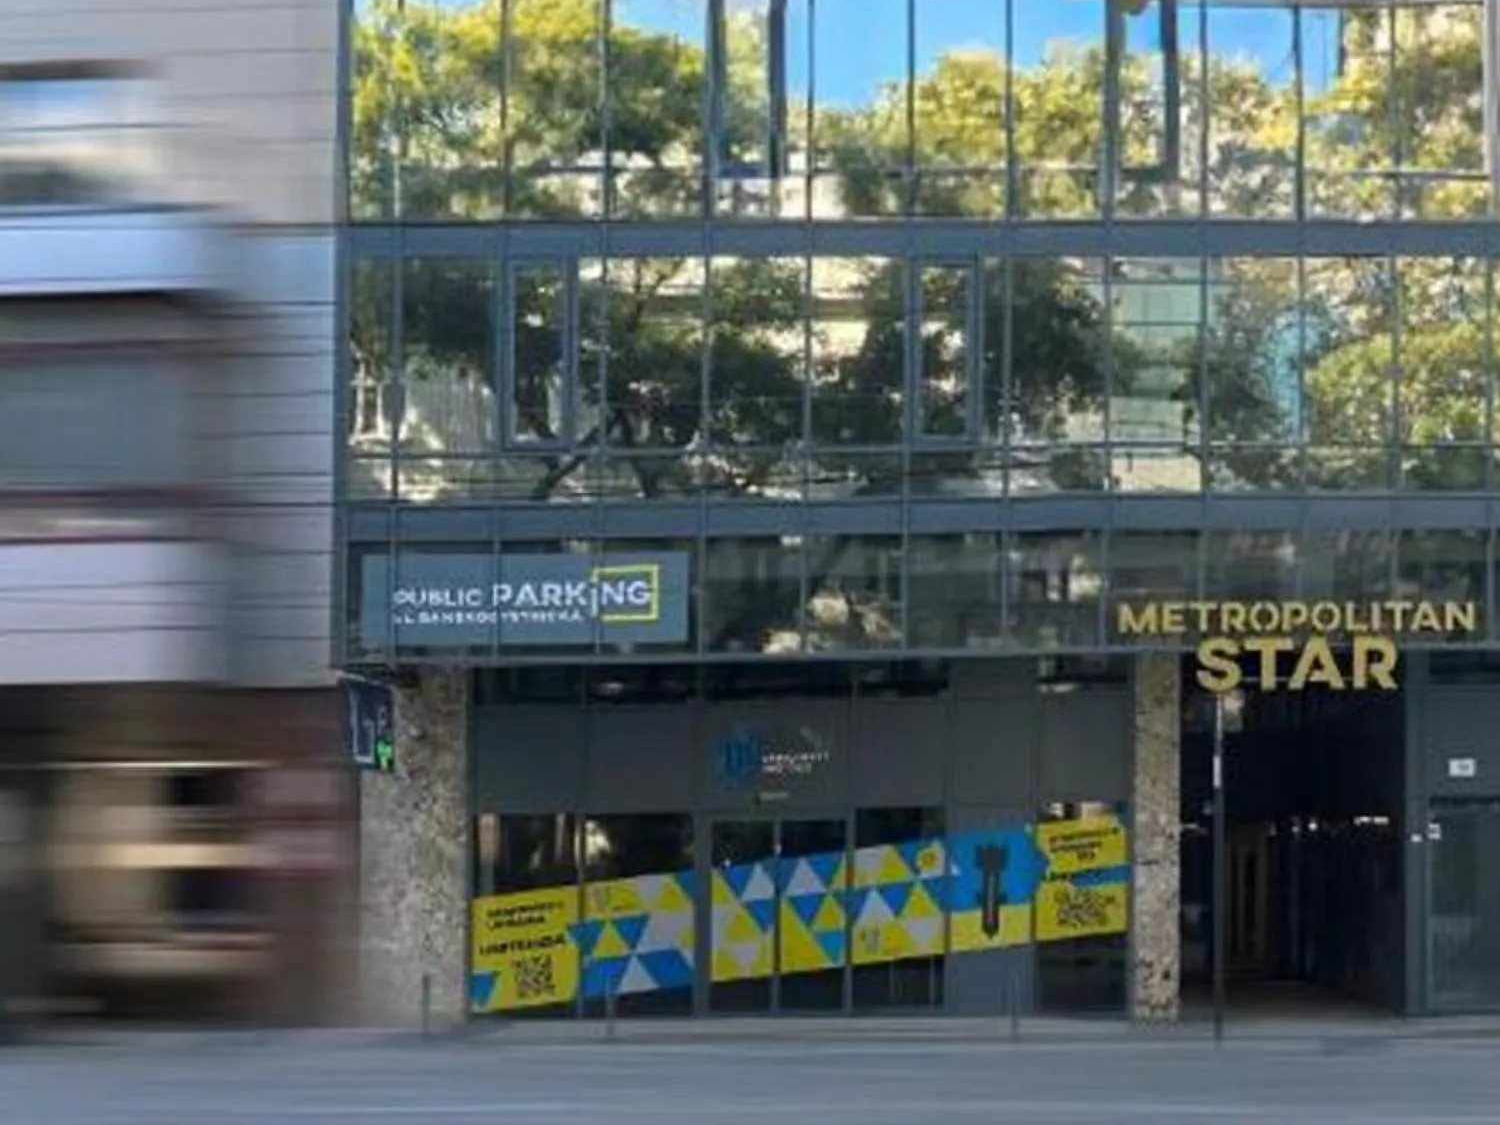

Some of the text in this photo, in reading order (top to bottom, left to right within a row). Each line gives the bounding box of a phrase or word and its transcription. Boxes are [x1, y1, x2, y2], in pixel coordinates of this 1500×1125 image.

[394, 584, 482, 607] PUBLIC
[1117, 600, 1475, 634] METROPOLITAN
[1195, 634, 1398, 692] STAR
